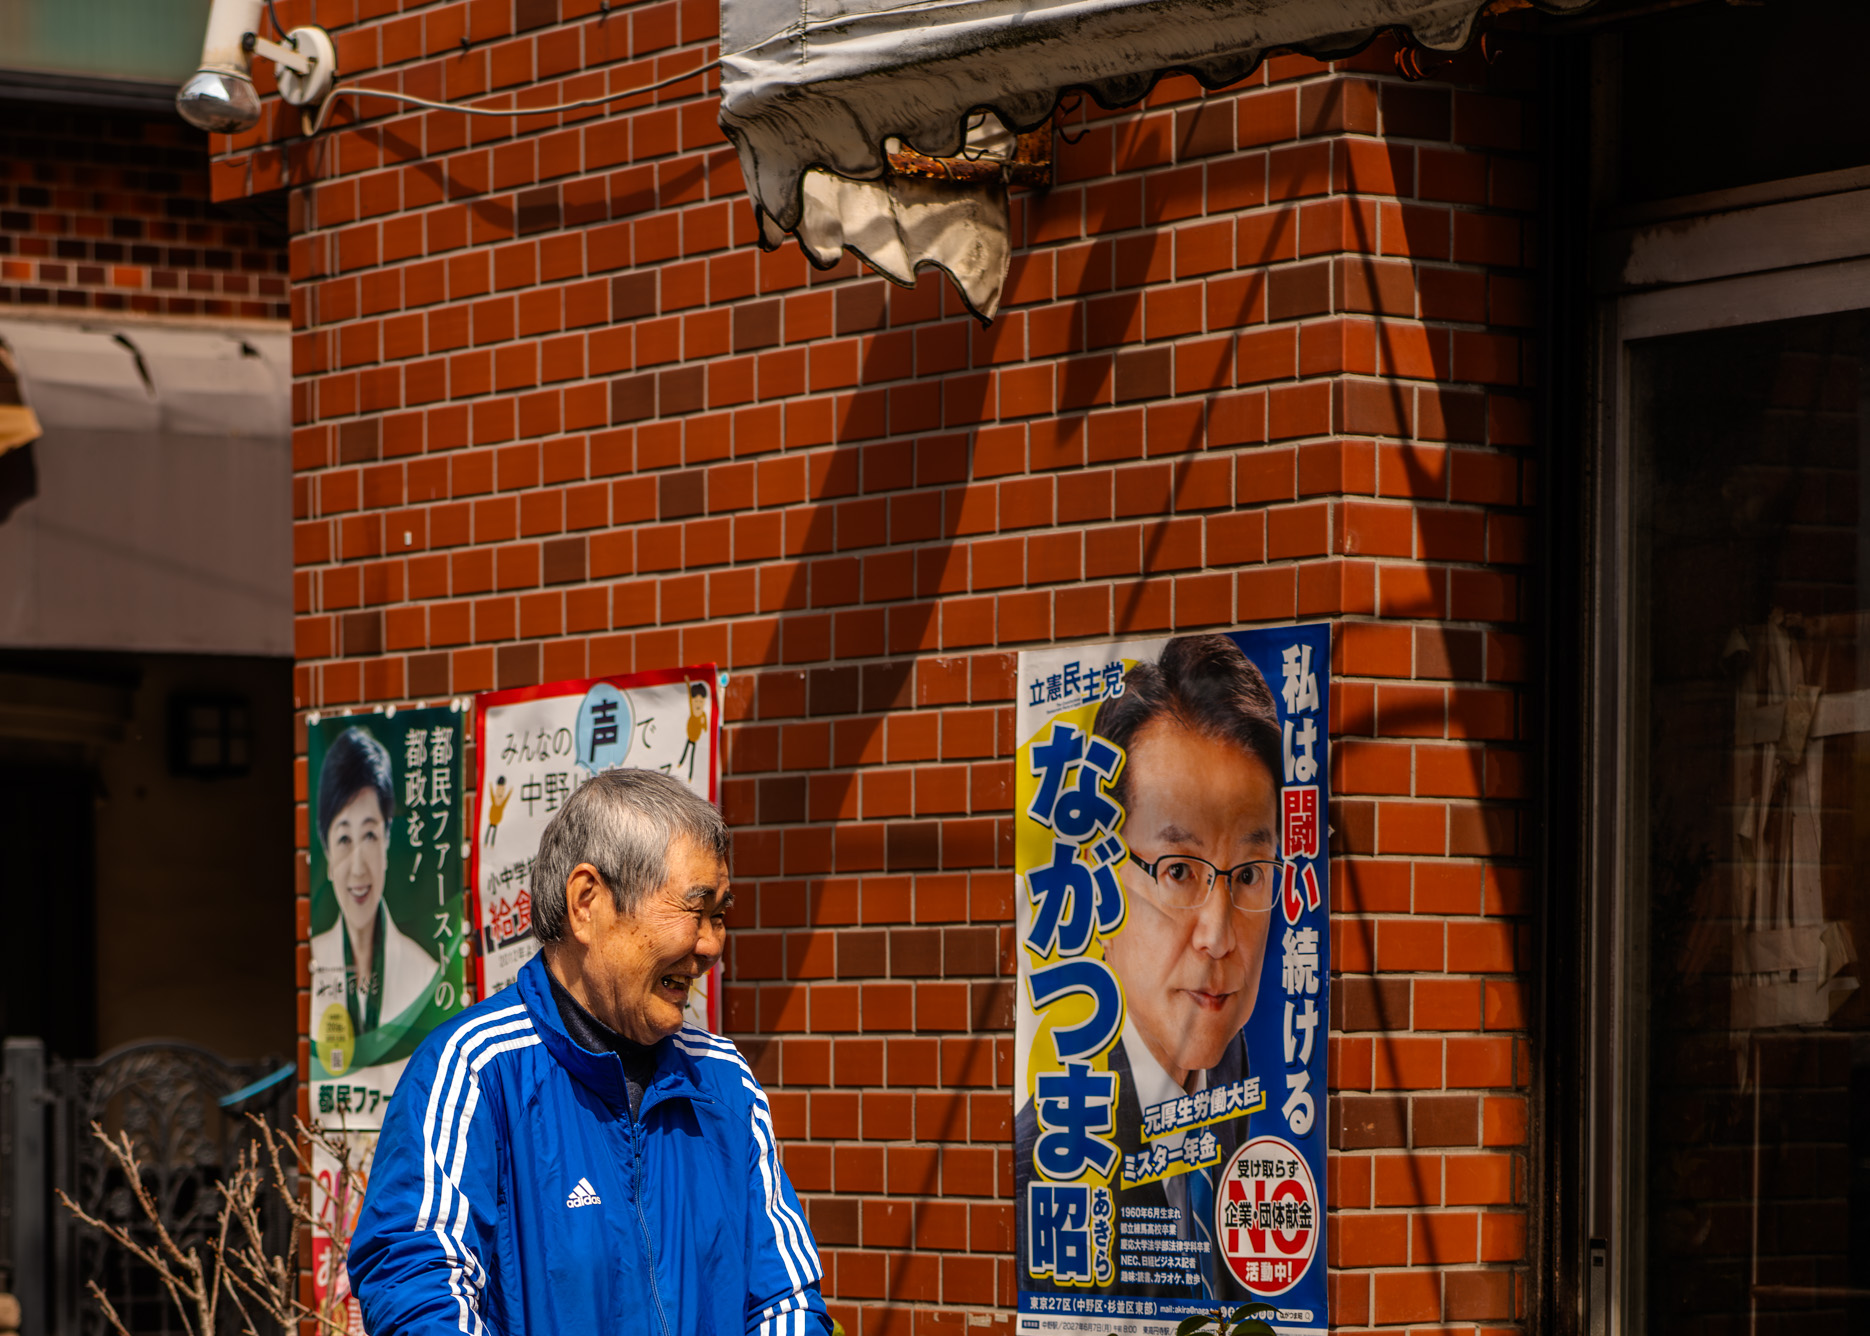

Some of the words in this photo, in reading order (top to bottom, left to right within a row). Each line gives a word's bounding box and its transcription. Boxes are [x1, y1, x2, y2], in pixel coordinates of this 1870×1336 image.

[1029, 661, 1124, 707] 立憲民主党
[404, 728, 428, 883] 都政を!
[430, 725, 455, 1012] 都民ファーストの
[1281, 643, 1321, 1137] 私は闘い続ける
[1025, 721, 1126, 1283] ながつま昭
[1143, 1076, 1262, 1136] 元厚生労働大臣
[1122, 1131, 1218, 1182] ミスター年金
[1237, 1159, 1299, 1179] 受け取らず
[566, 1195, 602, 1208] adidas
[1121, 1206, 1182, 1220] 1960年6月生まれ
[1224, 1200, 1313, 1230] 企業・団体献金
[1228, 1180, 1310, 1254] NO
[1092, 1187, 1113, 1282] あきら
[1245, 1261, 1292, 1283] 活動中!
